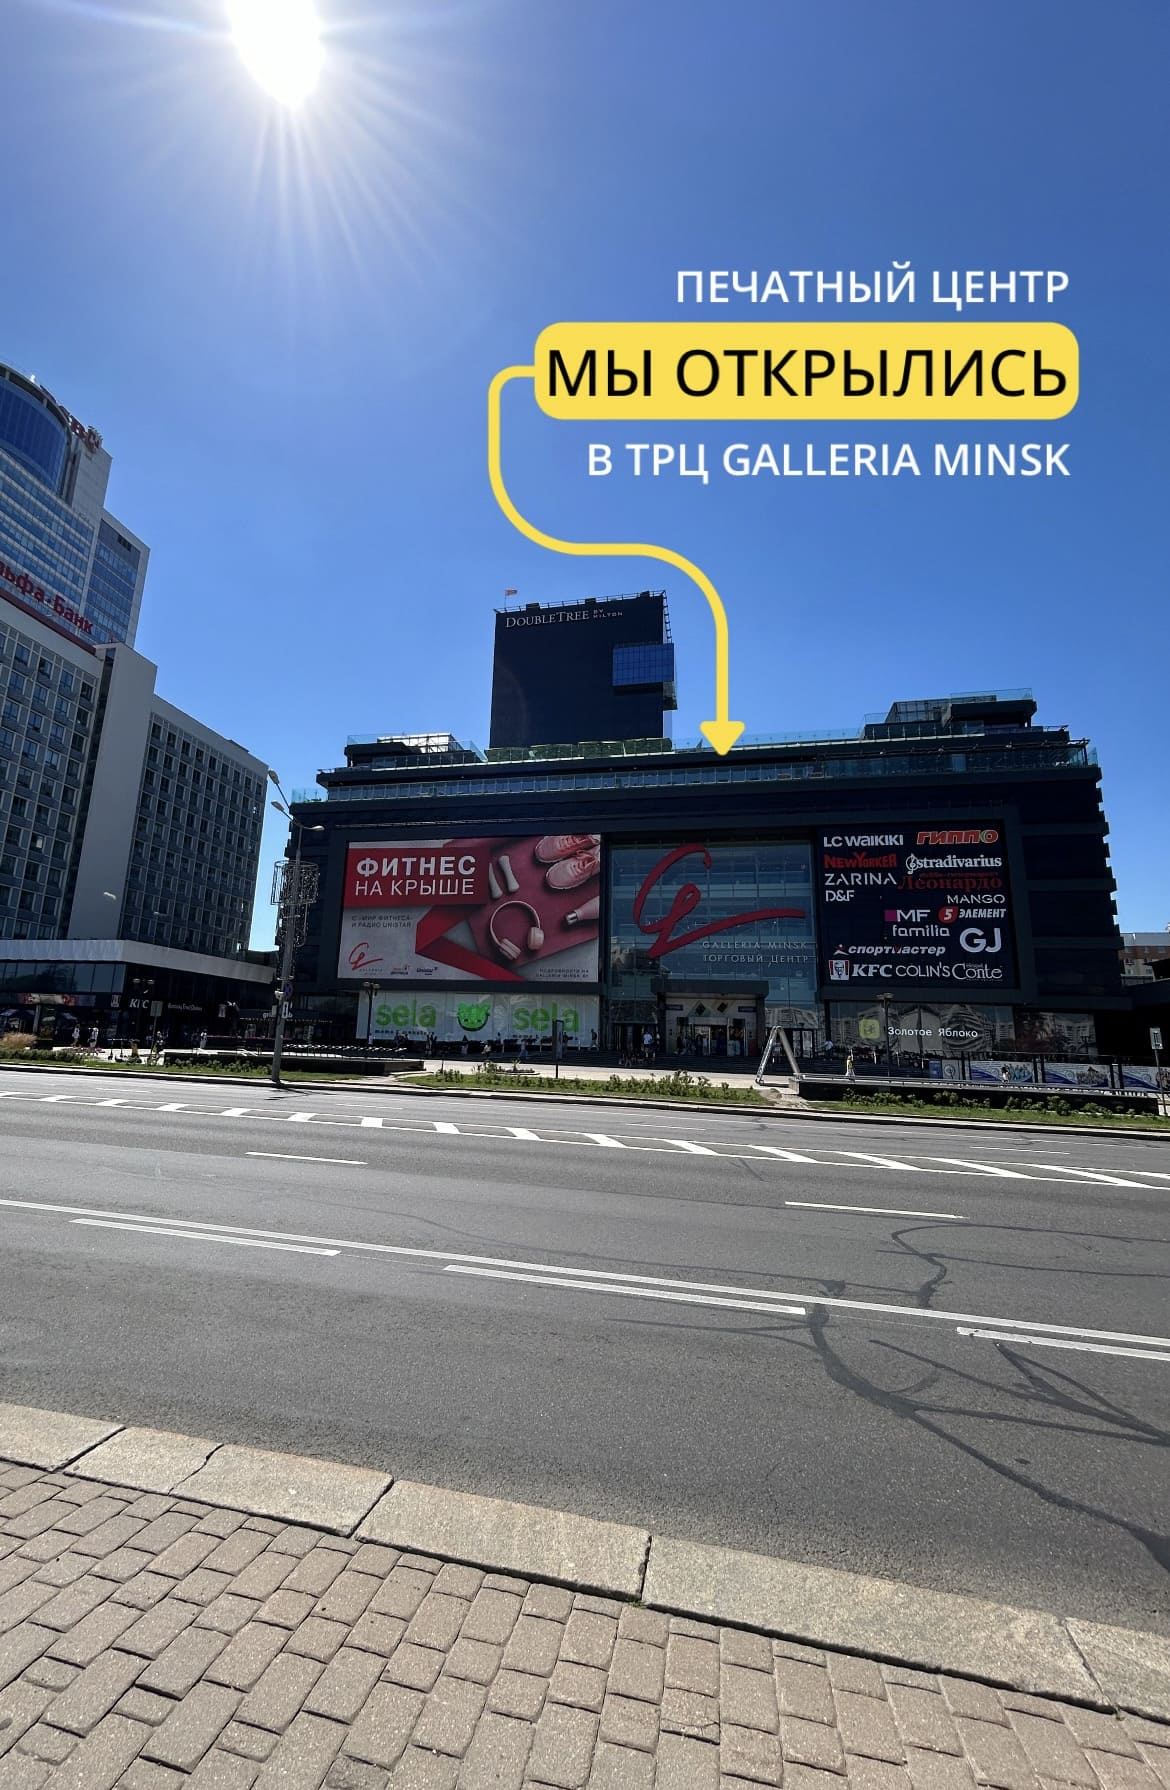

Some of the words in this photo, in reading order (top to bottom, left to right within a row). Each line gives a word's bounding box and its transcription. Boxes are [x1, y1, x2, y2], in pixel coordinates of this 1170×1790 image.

[505, 610, 590, 628] DOUBLETREE
[823, 836, 843, 848] LC
[916, 829, 999, 845] ГИППО
[356, 855, 476, 877] ФИТНЕС
[917, 854, 1002, 869] stradivarius
[824, 872, 897, 886] ZARINA
[897, 875, 1003, 892] Леонардо
[355, 880, 383, 896] НА
[390, 878, 475, 896] КРЫШЕ
[825, 890, 855, 902] D&F
[947, 894, 1006, 904] MANGO
[896, 909, 931, 922] MF
[944, 909, 953, 920] 5
[958, 908, 1007, 919] ЭЛЕМЕНТ
[892, 924, 950, 937] familia
[702, 941, 761, 950] GALLERIA
[767, 940, 808, 950] MINSK
[959, 927, 1002, 953] GJ
[703, 954, 763, 963] ТОРГОВЫЙ
[769, 955, 809, 967] ЦЕНТР
[852, 964, 893, 977] KFC
[895, 962, 950, 977] COLIN'S
[952, 963, 1003, 980] Conte
[375, 1000, 437, 1028] sela
[511, 1003, 579, 1032] sela
[887, 1026, 932, 1037] Золотое
[938, 1027, 978, 1038] Яблоко
